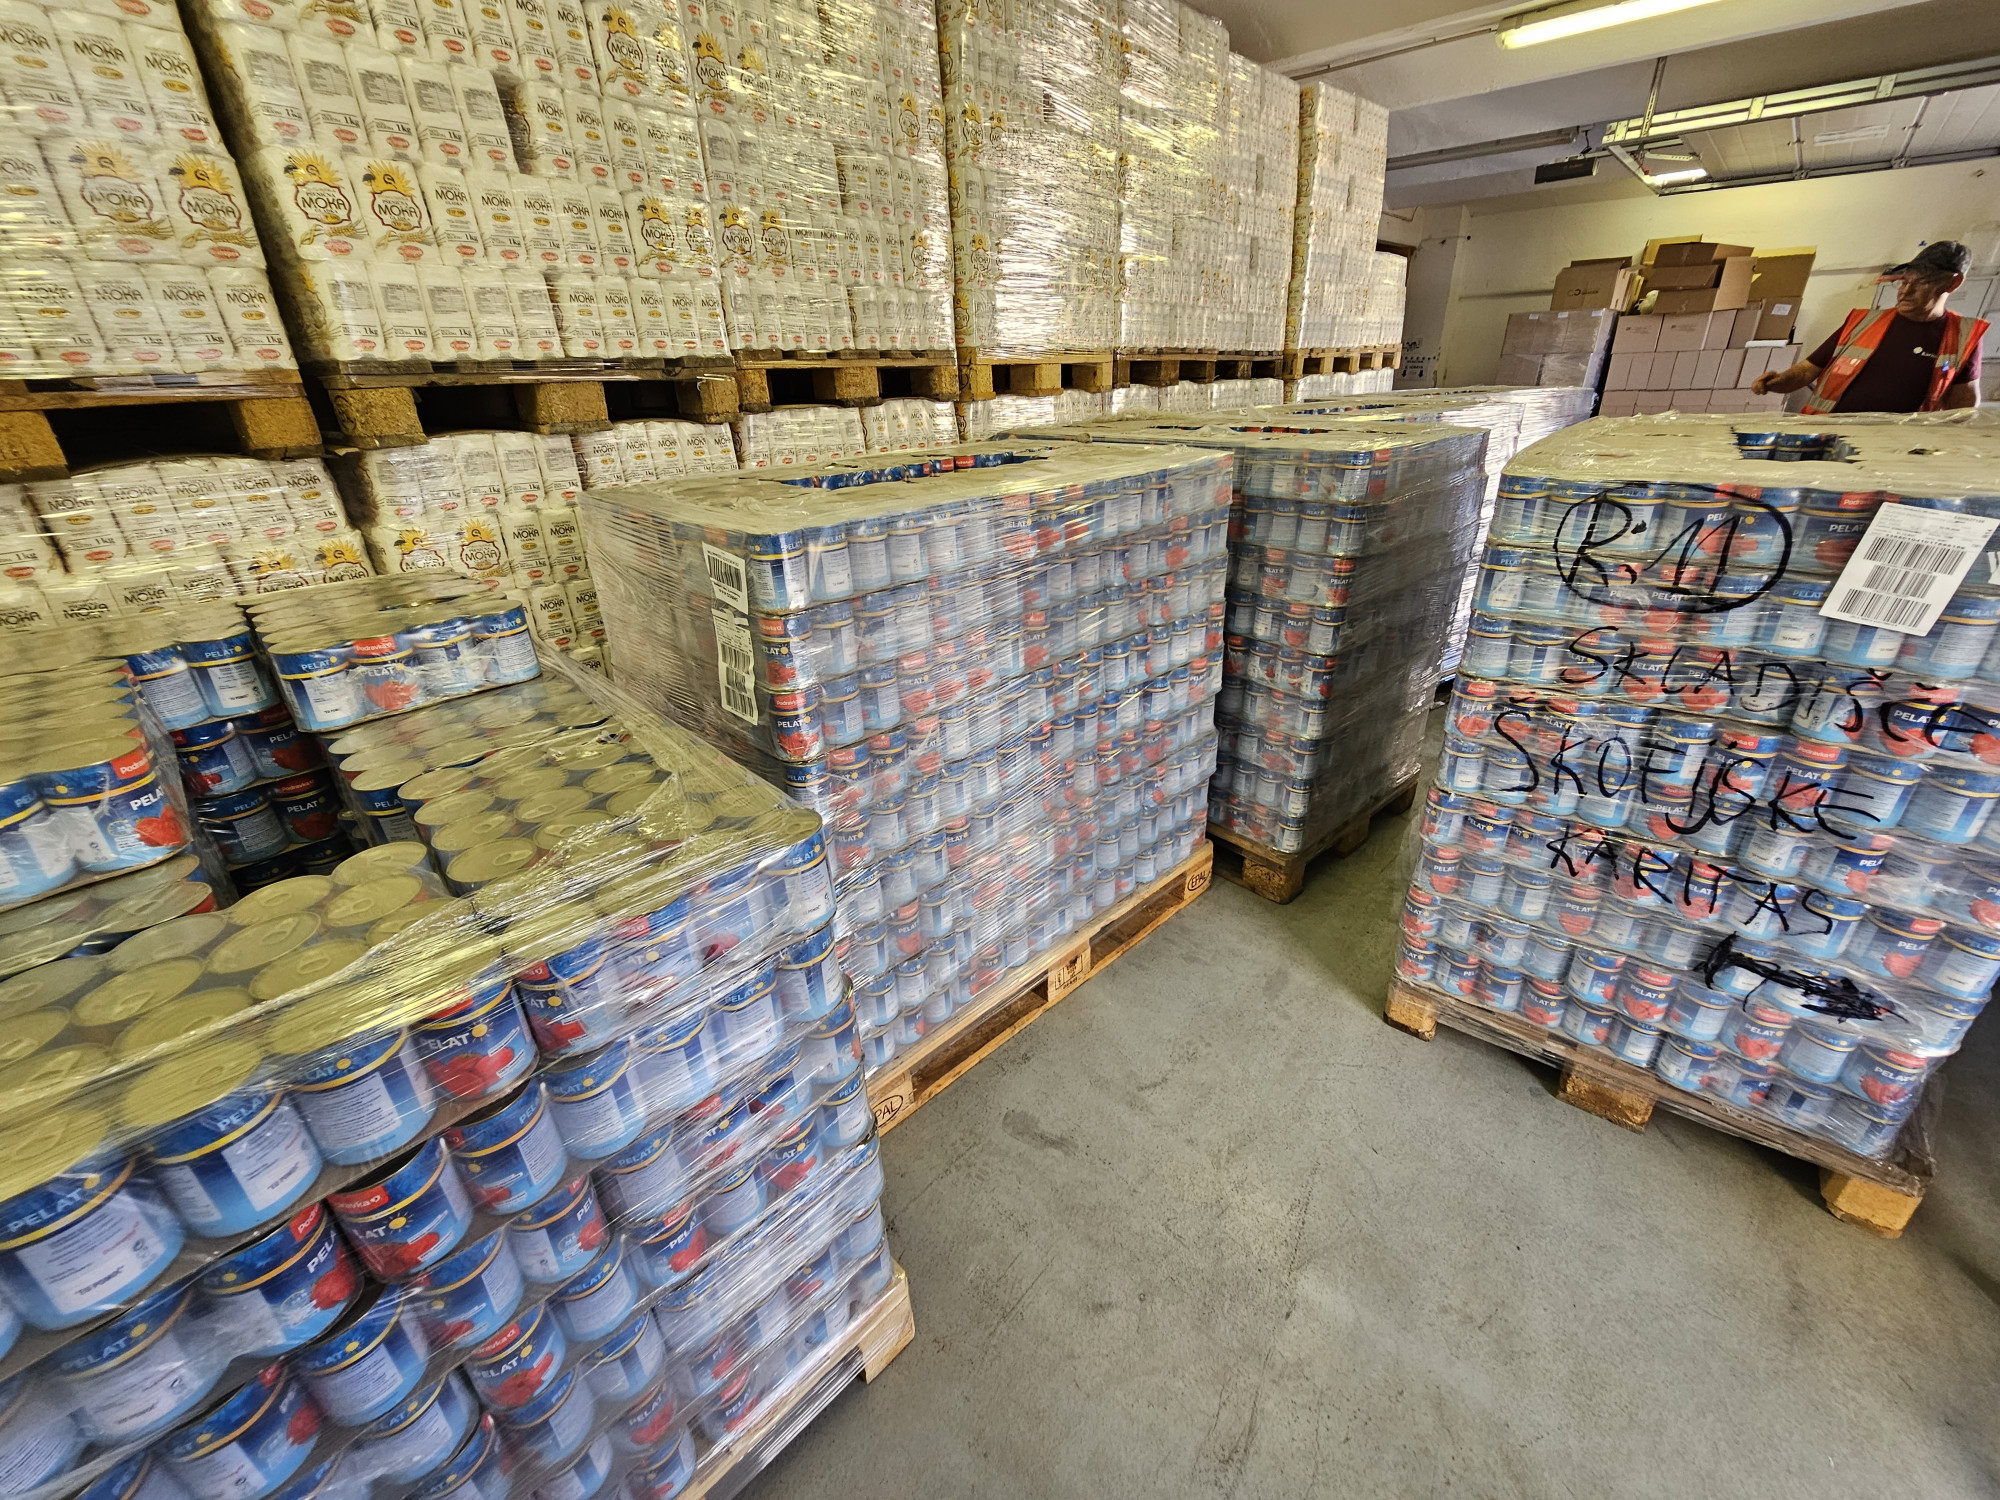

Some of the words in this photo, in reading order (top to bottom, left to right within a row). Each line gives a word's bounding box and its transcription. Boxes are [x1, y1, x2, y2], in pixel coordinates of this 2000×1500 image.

[74, 40, 127, 62] MOKA
[611, 43, 640, 60] MOKA
[145, 56, 192, 75] MOKA
[90, 191, 146, 209] MOKA
[435, 190, 467, 201] MOKA
[481, 196, 512, 207] MOKA
[187, 200, 235, 218] MOKA
[301, 197, 347, 210] MOKA
[524, 200, 553, 211] MOKA
[378, 204, 418, 217] MOKA
[563, 204, 590, 216] MOKA
[600, 208, 624, 219] MOKA
[96, 288, 143, 301] MOKA
[163, 290, 206, 302] MOKA
[227, 292, 267, 304] MOKA
[569, 293, 594, 303] MOKA
[605, 295, 629, 304] MOKA
[287, 476, 321, 488] MOKA
[513, 529, 539, 539] MOKA
[550, 526, 575, 535] MOKA
[823, 533, 842, 544] PELAT
[465, 551, 497, 561] MOKA
[124, 589, 167, 604] MOKA
[1793, 589, 1823, 599] PELAT
[540, 600, 564, 610] MOKA
[493, 621, 516, 631] PELAT
[1287, 619, 1305, 627] PELAT
[205, 650, 234, 659] PELAT
[302, 660, 329, 670] PELAT
[1632, 662, 1661, 672] PELAT
[1462, 703, 1487, 711] PELAT
[778, 720, 803, 728] PELAT
[1786, 765, 1821, 781] PELAT
[287, 801, 319, 813] PELAT
[1656, 804, 1684, 814] PELAT
[785, 849, 815, 867] PELAT
[1546, 821, 1833, 936] KARITAS
[1566, 902, 1591, 913] PELAT
[1631, 984, 1658, 998] PELAT
[1746, 1024, 1776, 1037] PELAT
[1875, 1066, 1911, 1083] PELAT
[839, 1080, 861, 1099] PELAT
[875, 1101, 897, 1119] PAL
[8, 1188, 82, 1232] PELAT
